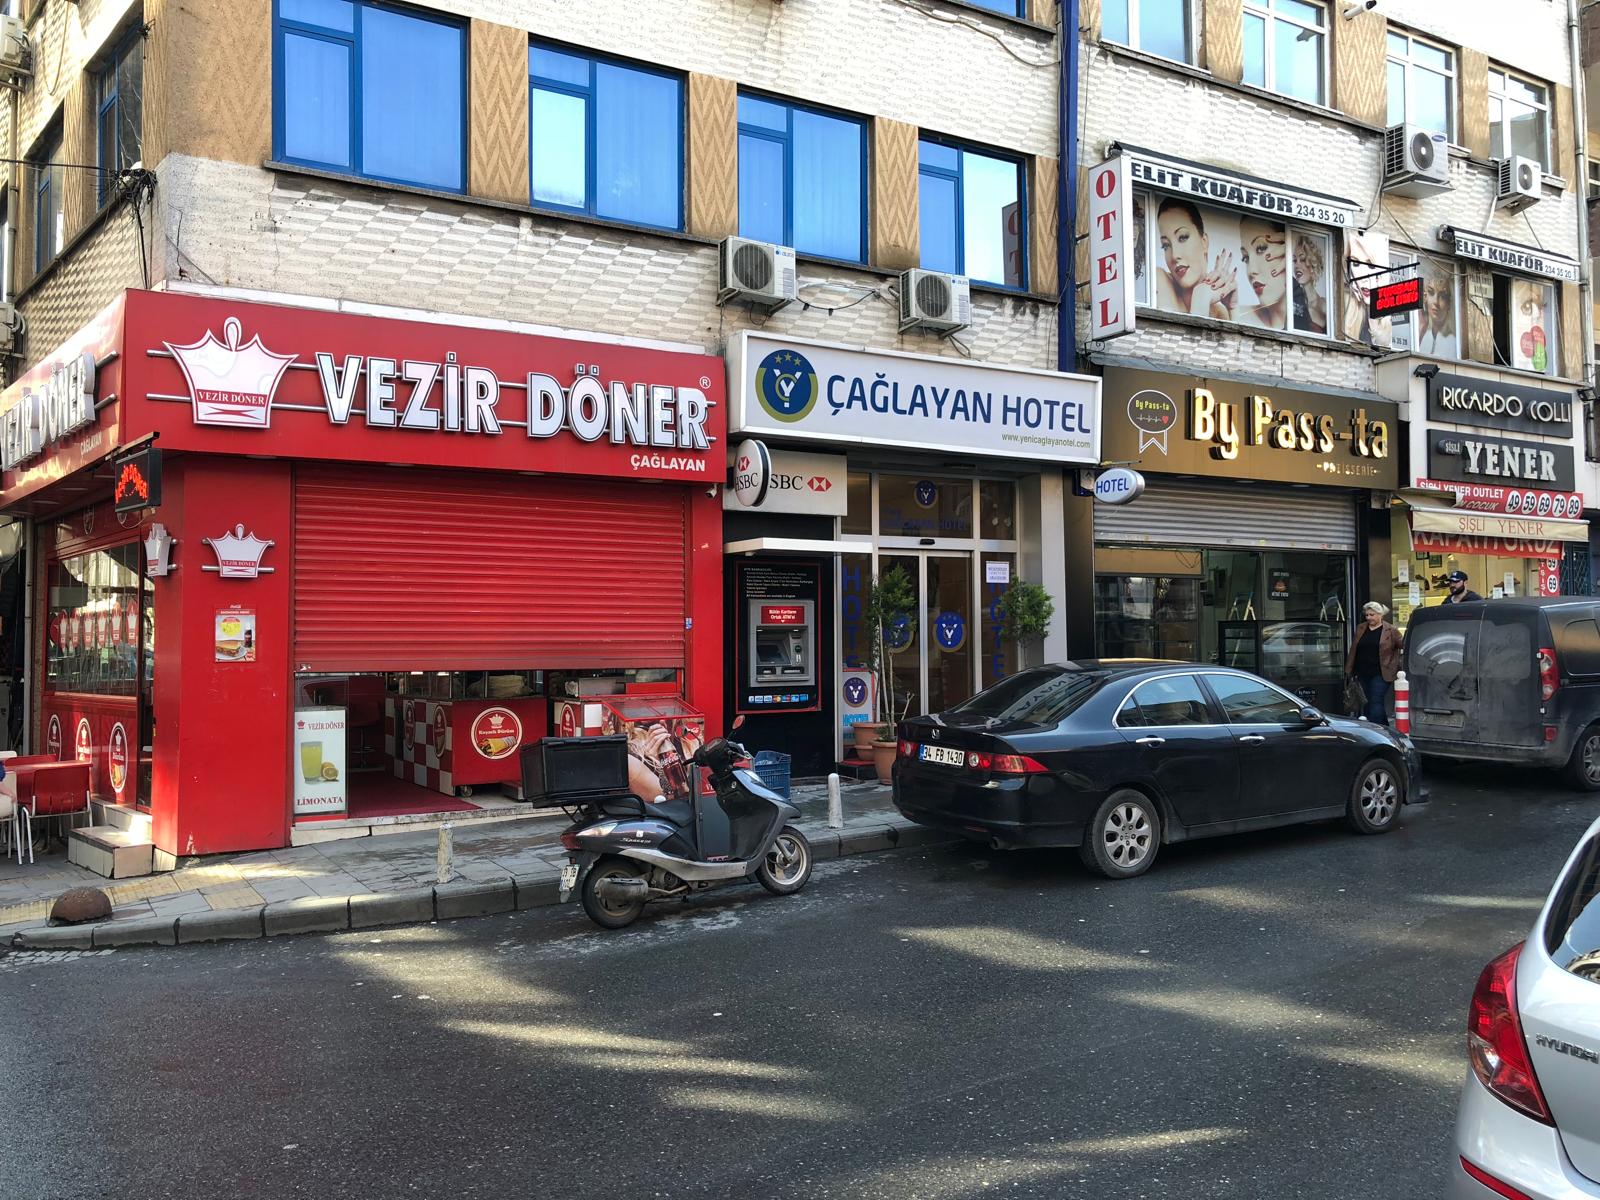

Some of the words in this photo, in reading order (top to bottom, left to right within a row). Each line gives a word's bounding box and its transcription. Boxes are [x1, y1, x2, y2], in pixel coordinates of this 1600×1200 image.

[1191, 177, 1293, 214] KUAFÖR
[1296, 203, 1316, 219] 234
[1318, 208, 1331, 222] 35
[1333, 210, 1345, 225] 20
[1489, 247, 1544, 272] KUAFÖR
[198, 391, 229, 401] VEZİR
[231, 393, 265, 405] DÖNER
[315, 350, 502, 434] VEZİR
[527, 363, 711, 450] DÖNER
[826, 372, 992, 425] ÇAĞLAYAN
[1002, 394, 1092, 434] HOTEL
[1526, 400, 1571, 423] COLLI
[1001, 433, 1091, 448] www.yenicaglayanotel.com
[630, 453, 706, 472] ÇAĞLAYAN
[1464, 440, 1557, 482] YENER
[735, 472, 759, 492] HSBC
[769, 473, 803, 491] SBC
[1095, 477, 1130, 494] HOTEL
[1473, 487, 1504, 499] OUTLET
[1507, 494, 1520, 509] 49
[1523, 495, 1535, 510] 59
[1539, 497, 1550, 512] 69
[1554, 499, 1565, 514] 79
[1569, 501, 1579, 516] 89
[1498, 520, 1544, 536] YENER
[1549, 577, 1556, 590] 69
[308, 722, 325, 731] VEZİR
[325, 721, 345, 730] DÖNER
[924, 747, 931, 757] 34
[936, 750, 944, 759] FB
[947, 752, 963, 764] 1430
[297, 796, 343, 806] LİMONATA
[1535, 1032, 1599, 1064] HYUNDAI
